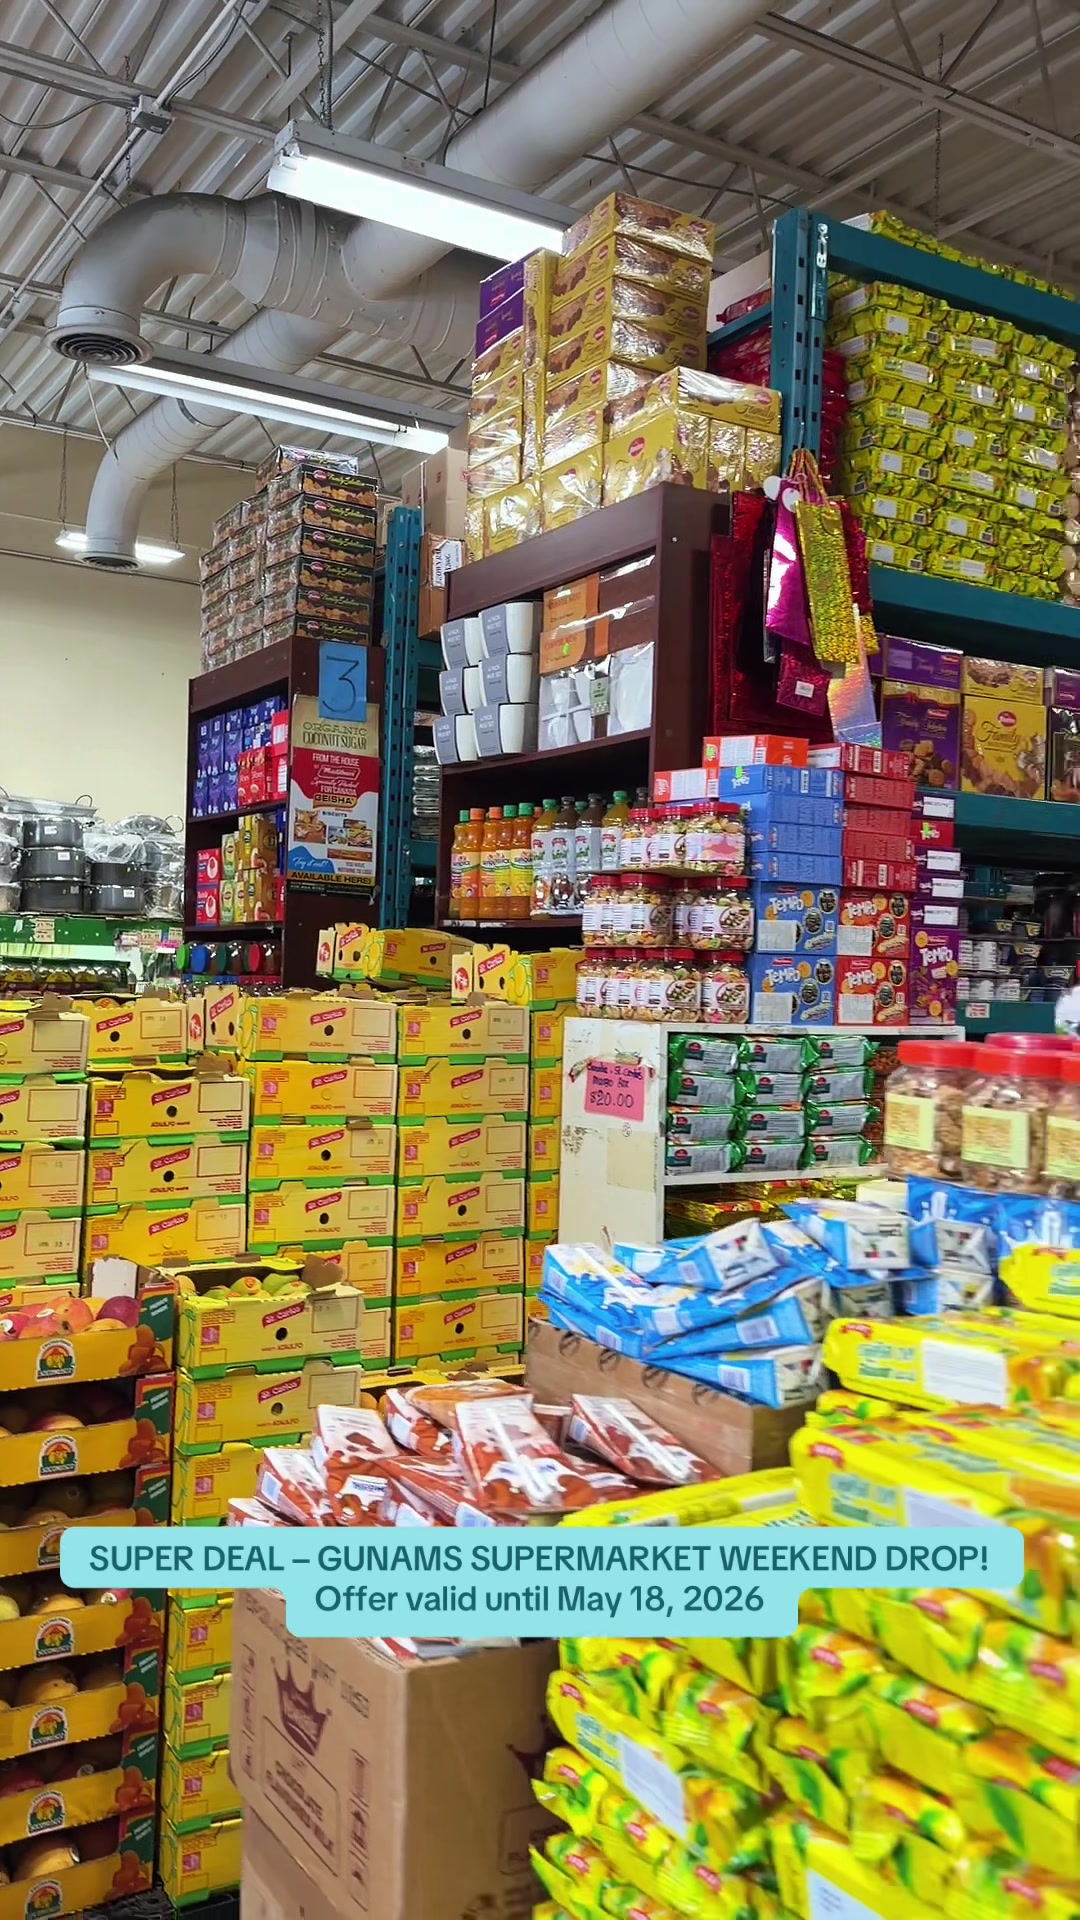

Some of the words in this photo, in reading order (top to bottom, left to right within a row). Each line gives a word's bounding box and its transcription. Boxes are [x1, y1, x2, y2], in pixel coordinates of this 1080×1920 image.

[322, 655, 360, 713] 3
[302, 721, 368, 737] ORGANIC
[312, 753, 329, 763] FROM
[330, 755, 341, 764] THE
[341, 757, 360, 767] HOUSE
[314, 793, 352, 805] GEISHA
[291, 871, 342, 883] AVAILABLE
[344, 876, 372, 885] HERE!
[589, 1089, 635, 1108] $20.00
